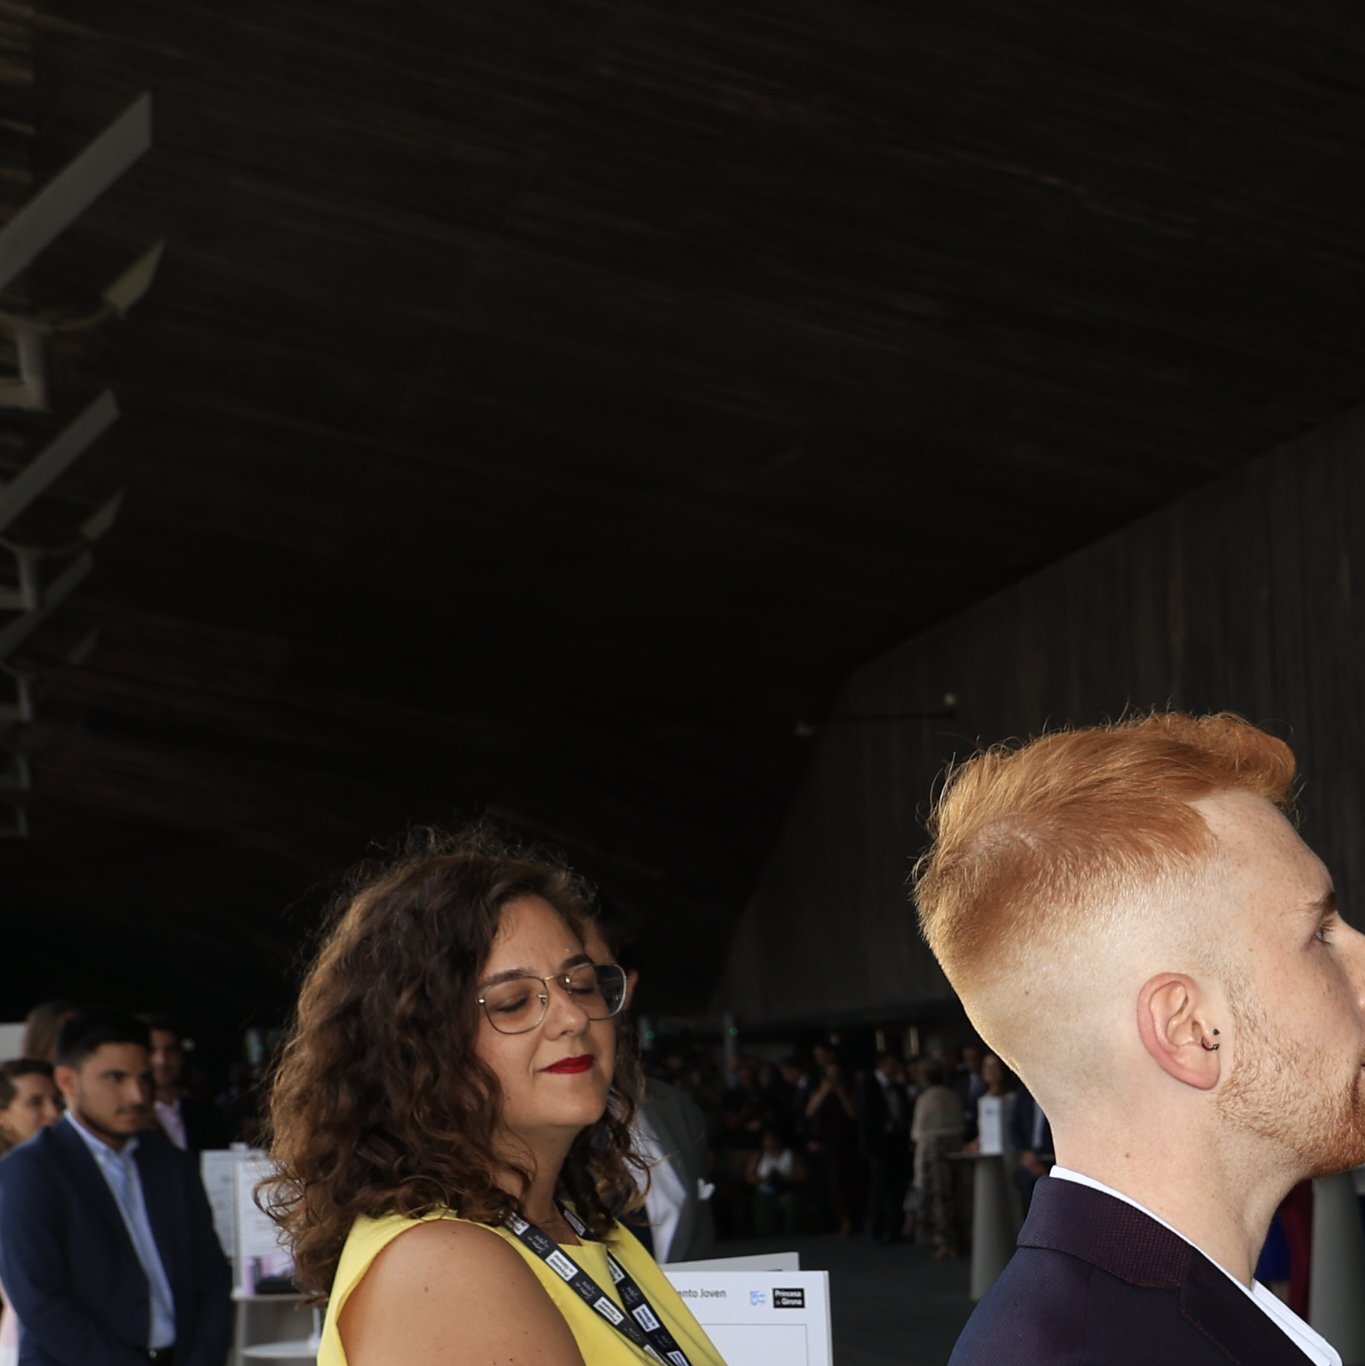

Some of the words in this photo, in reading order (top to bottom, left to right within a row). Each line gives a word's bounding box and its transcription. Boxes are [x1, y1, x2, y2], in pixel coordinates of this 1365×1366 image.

[677, 1289, 698, 1298] ento
[700, 1289, 726, 1299] Joven
[774, 1289, 802, 1298] Princesa
